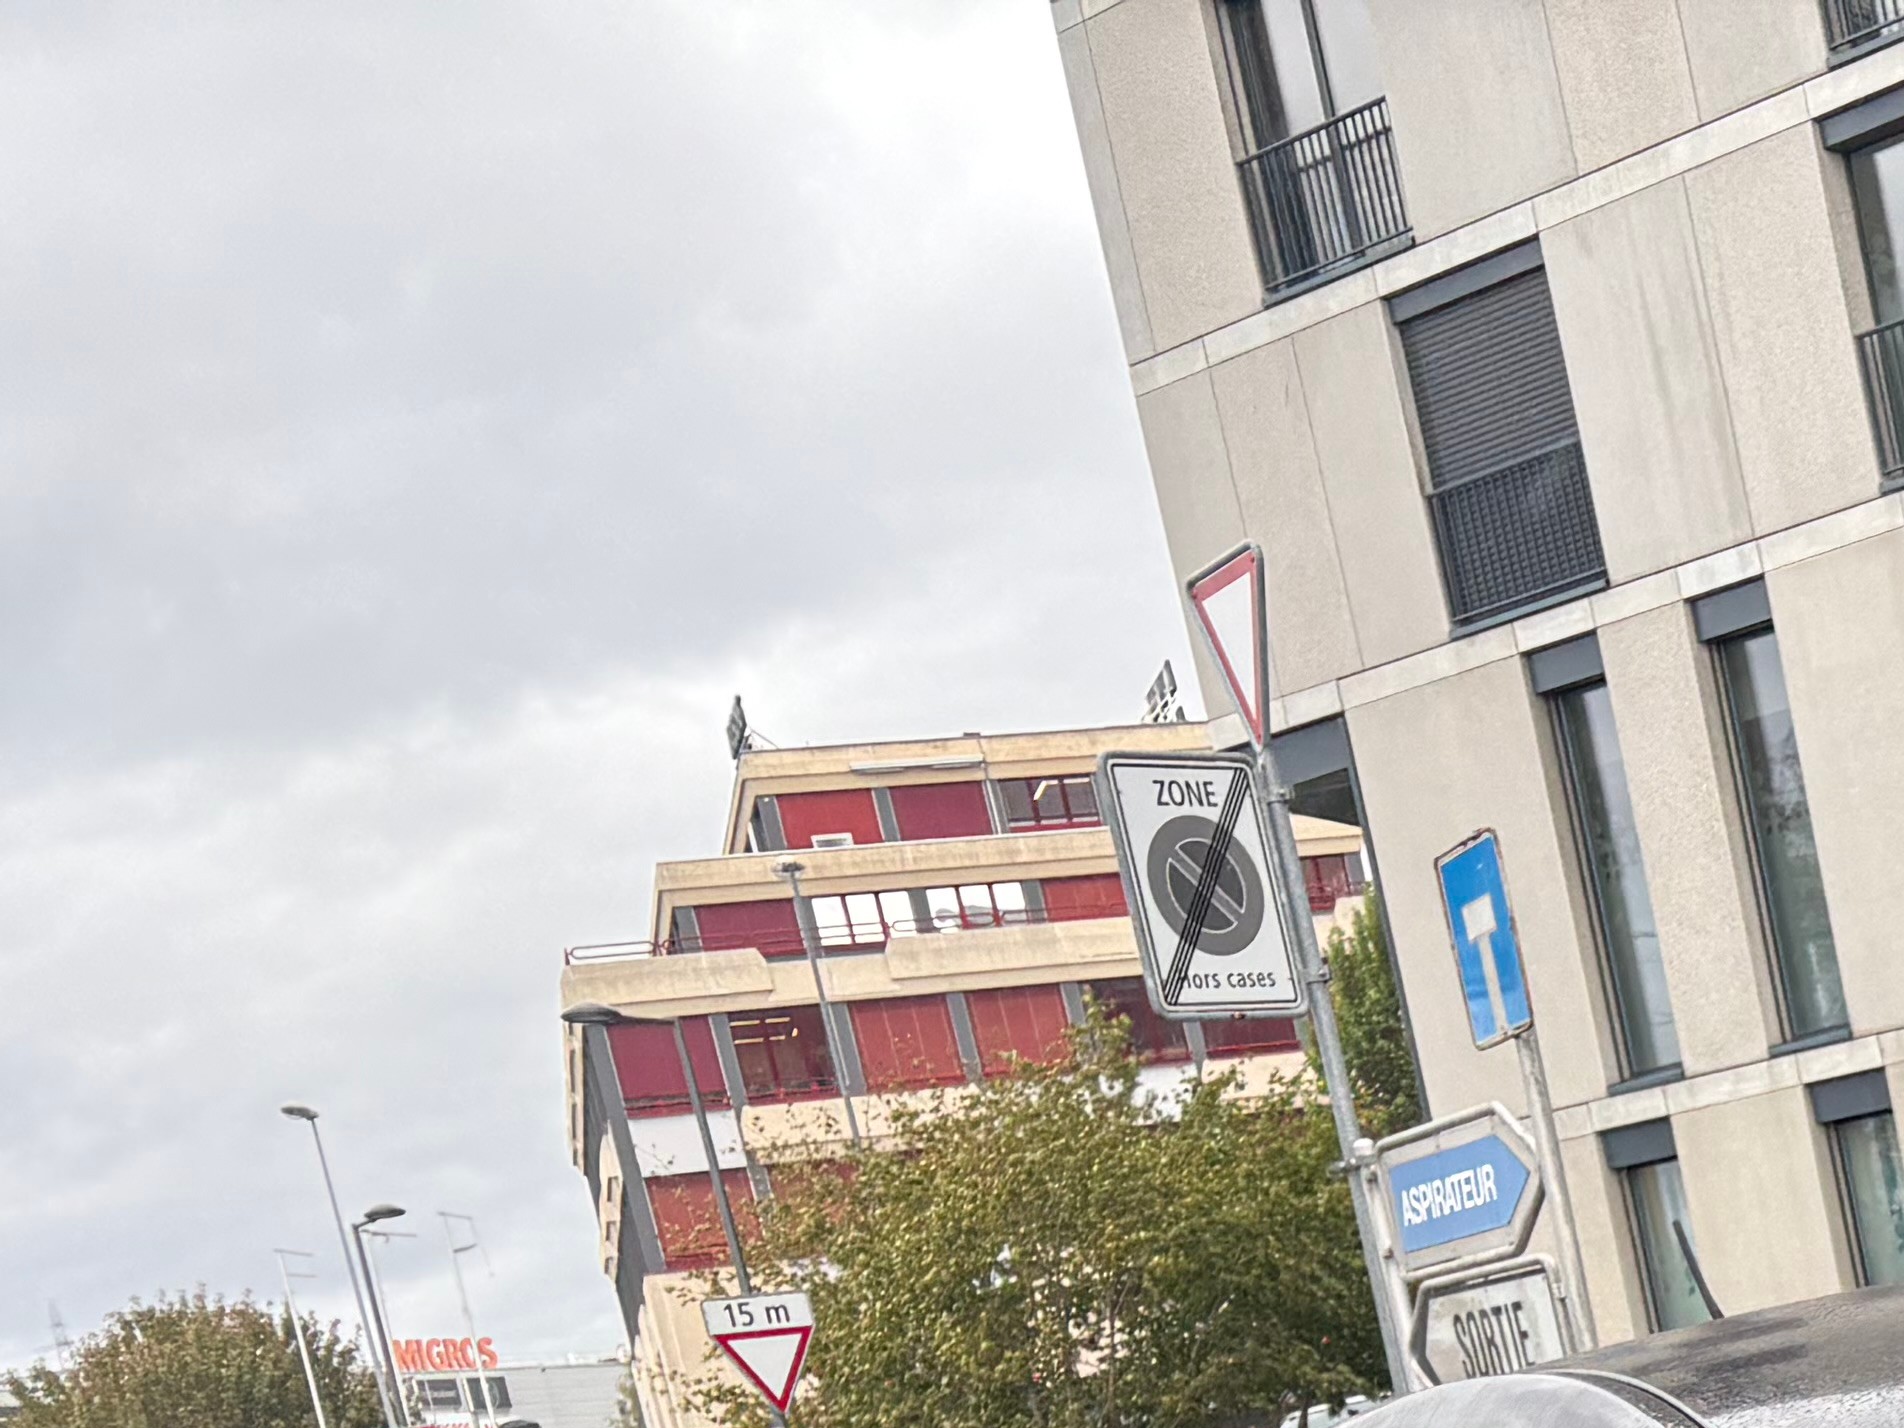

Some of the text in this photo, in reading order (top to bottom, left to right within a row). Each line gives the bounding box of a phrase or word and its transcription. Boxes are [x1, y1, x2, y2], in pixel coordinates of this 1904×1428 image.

[1152, 779, 1219, 808] ZONE
[1227, 971, 1276, 989] cases
[1401, 1163, 1498, 1227] ASPIRATEUR
[723, 1301, 790, 1328] 15 m
[392, 1337, 499, 1372] MIGROS
[1453, 1300, 1536, 1380] SORTIE
